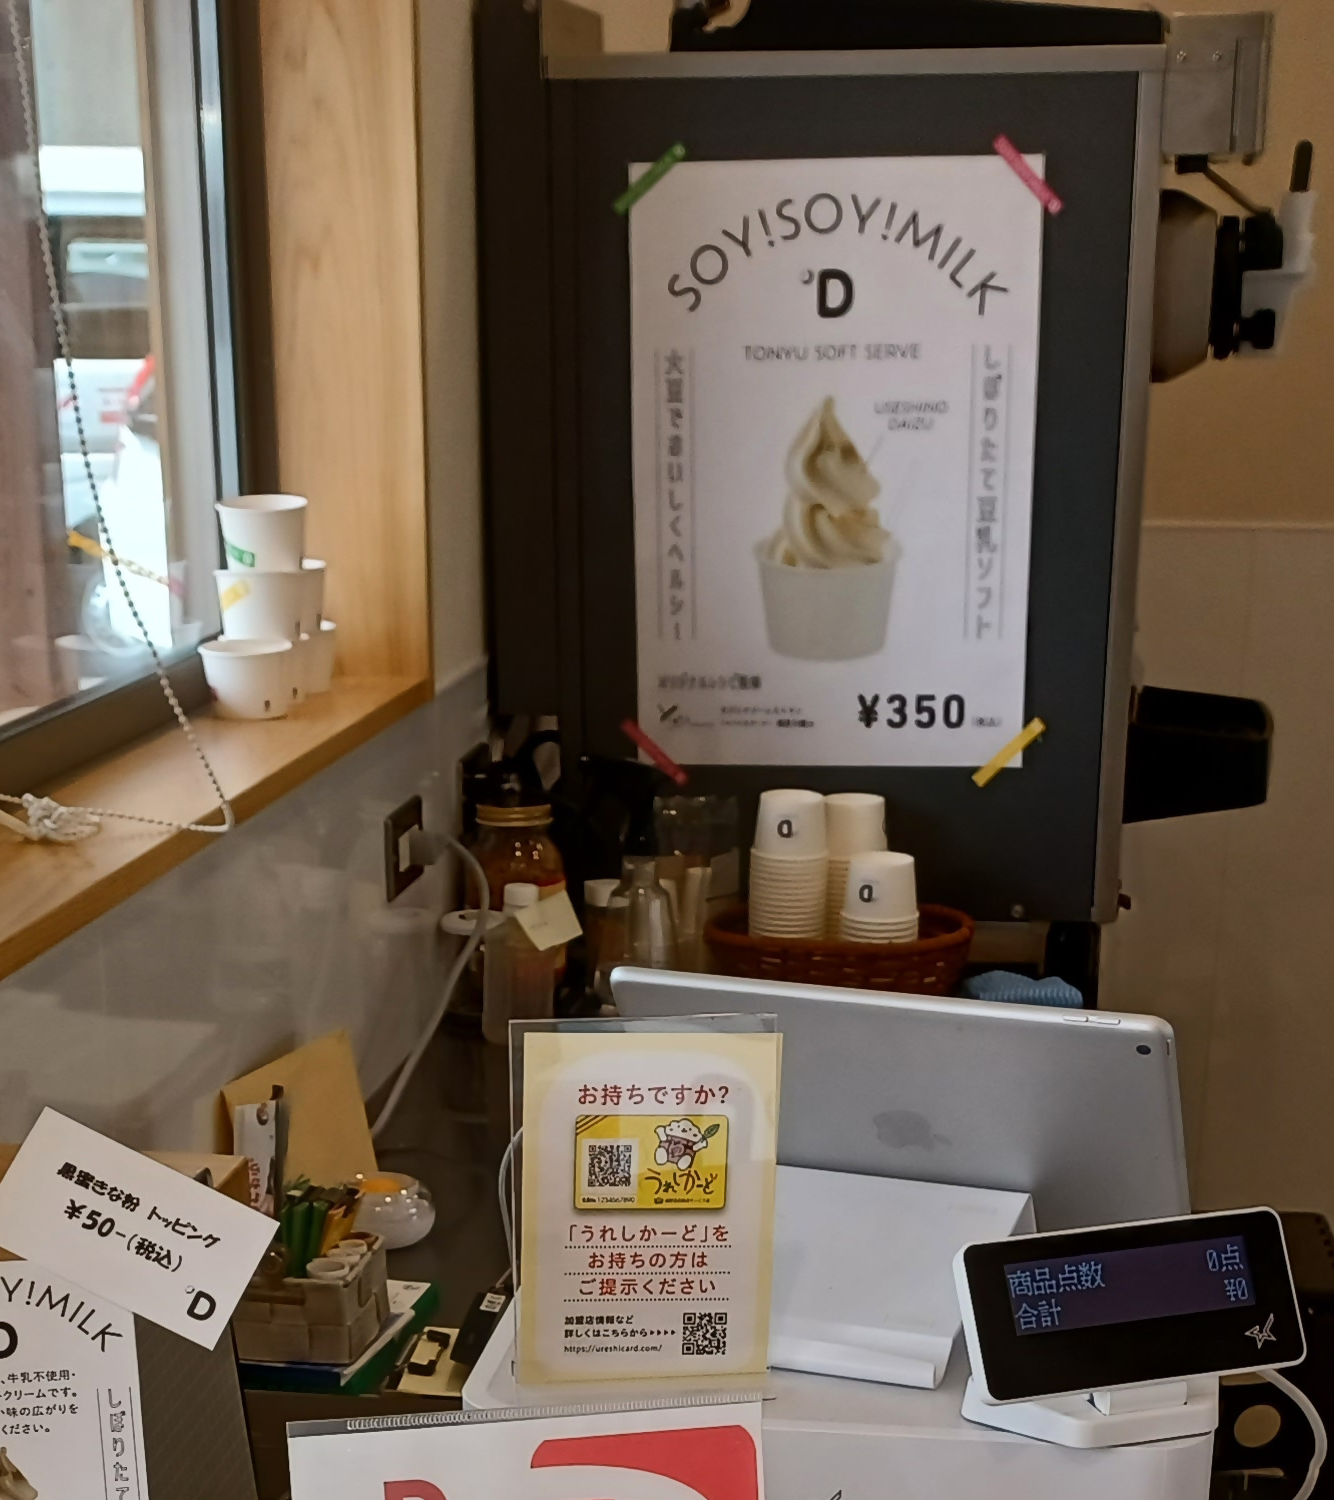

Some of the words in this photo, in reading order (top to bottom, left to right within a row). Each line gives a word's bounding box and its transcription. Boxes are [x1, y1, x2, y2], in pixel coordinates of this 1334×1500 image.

[668, 193, 1008, 316] SOY!SOY!MILK
[815, 344, 858, 361] SOFT
[866, 343, 921, 360] SERVE
[858, 694, 966, 729] ¥350
[577, 1084, 730, 1106] お持ちですか?
[56, 1162, 140, 1213] 黒蜜きな粉
[147, 1205, 221, 1249] トッピング
[568, 1225, 730, 1243] 「うれしかーど」を
[589, 1252, 708, 1269] お持ちの方は
[578, 1278, 716, 1296] ご提示ください
[1007, 1261, 1106, 1299] 商品点数
[1014, 1299, 1062, 1331] 合計
